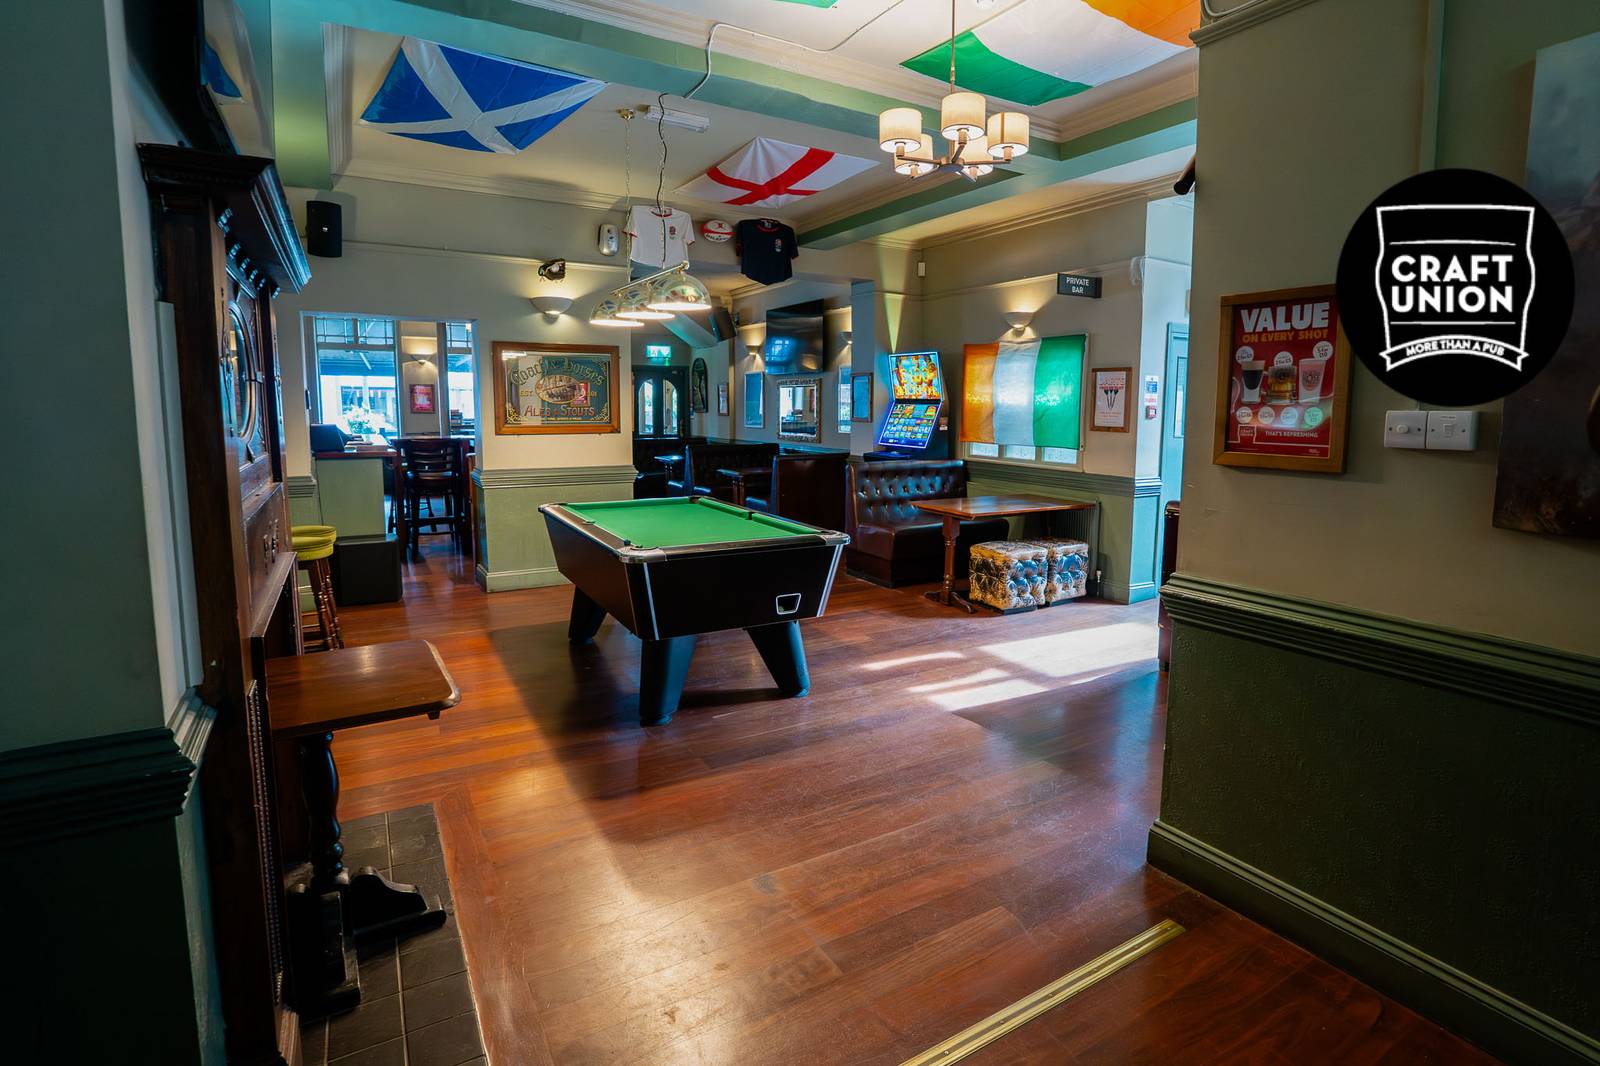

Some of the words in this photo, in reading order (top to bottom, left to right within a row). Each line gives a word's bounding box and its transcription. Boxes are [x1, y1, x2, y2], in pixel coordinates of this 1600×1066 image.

[1066, 276, 1089, 287] PRIVATE
[1071, 286, 1084, 294] BAR
[1240, 302, 1330, 333] VALUE
[1242, 333, 1259, 343] ON
[1260, 331, 1295, 343] EVERY
[1298, 329, 1329, 340] SHOT
